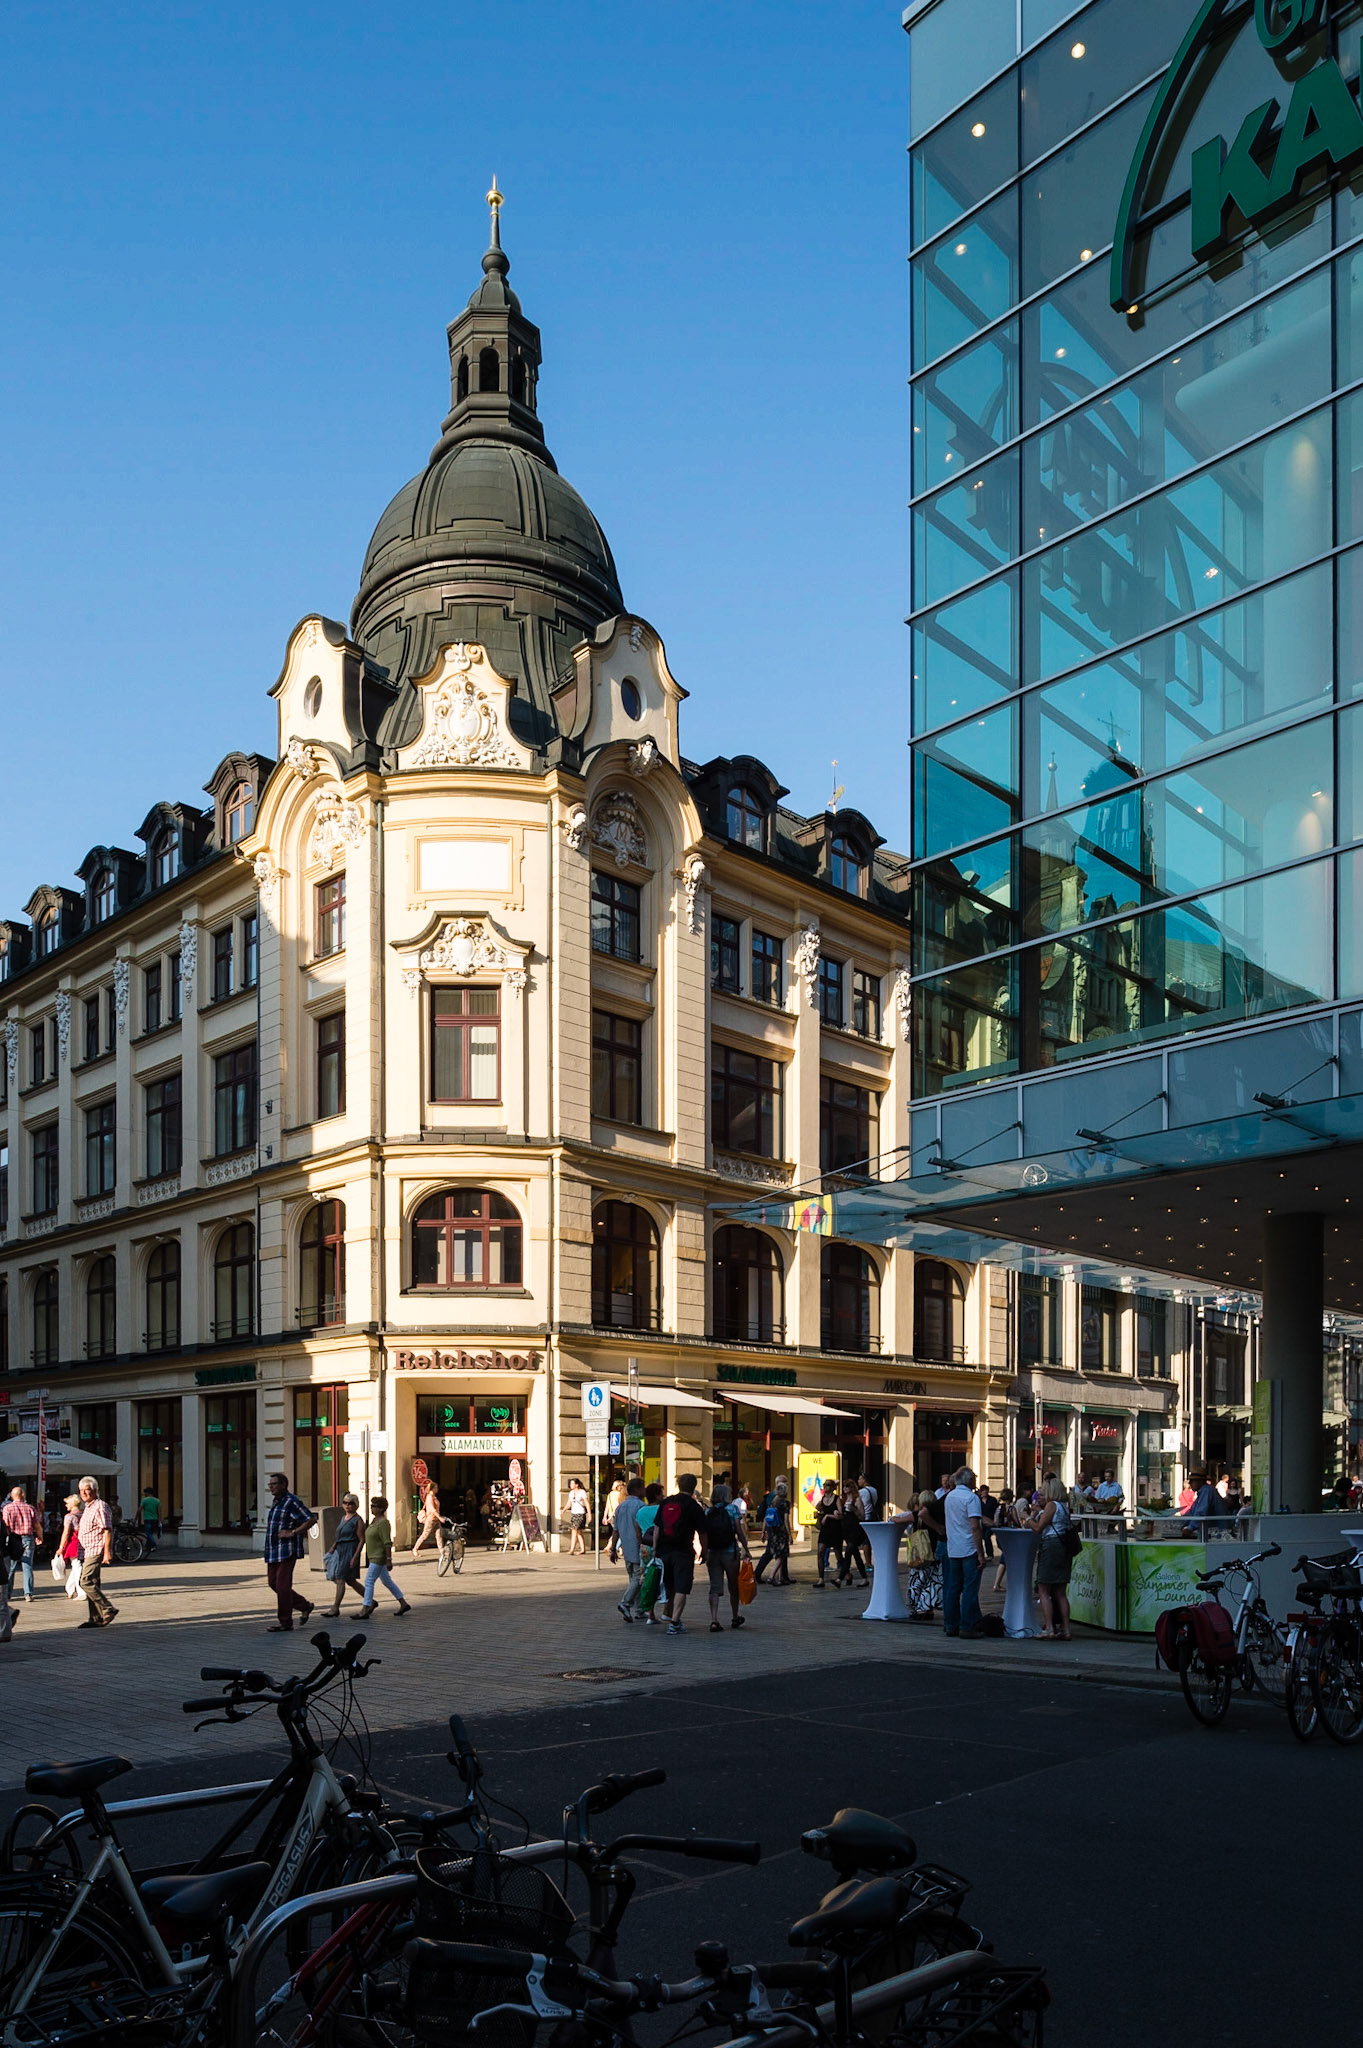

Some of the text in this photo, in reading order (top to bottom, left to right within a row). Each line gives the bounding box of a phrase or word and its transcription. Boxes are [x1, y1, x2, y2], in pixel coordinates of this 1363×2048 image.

[1191, 42, 1363, 262] KA
[393, 1348, 539, 1371] Reichshof
[588, 1409, 603, 1417] ZONE
[440, 1439, 503, 1451] SALAMANDER
[812, 1457, 823, 1465] WE
[1135, 1576, 1190, 1592] Summer
[1154, 1589, 1203, 1605] Lounge
[268, 1826, 312, 1909] PEGASUS
